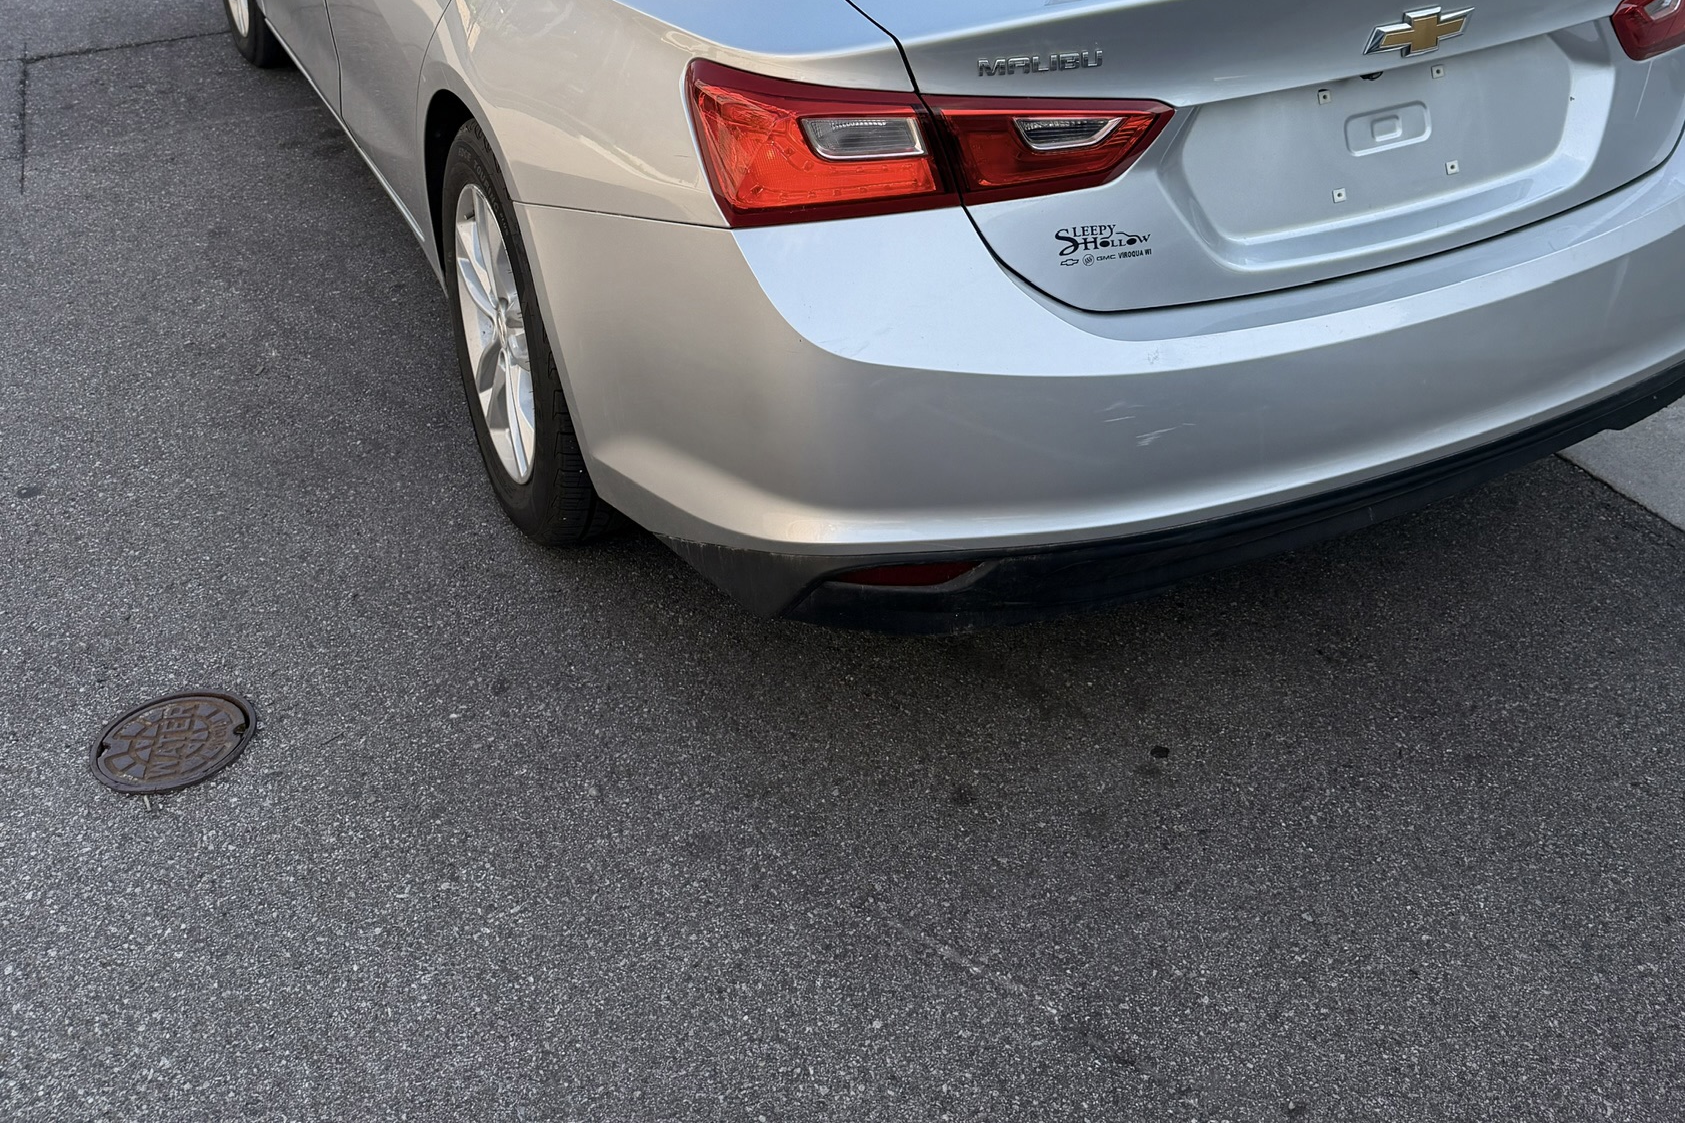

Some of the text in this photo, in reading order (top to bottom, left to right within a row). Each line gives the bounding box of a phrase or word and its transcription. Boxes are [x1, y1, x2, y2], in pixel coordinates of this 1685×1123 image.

[978, 50, 1103, 77] MALIBU
[473, 159, 499, 213] TOURING
[1054, 224, 1117, 257] SLEEPY
[1081, 233, 1151, 251] HOLLOW
[1096, 254, 1116, 262] GMC
[1118, 250, 1144, 259] VIROQUA
[147, 705, 198, 780] WATER
